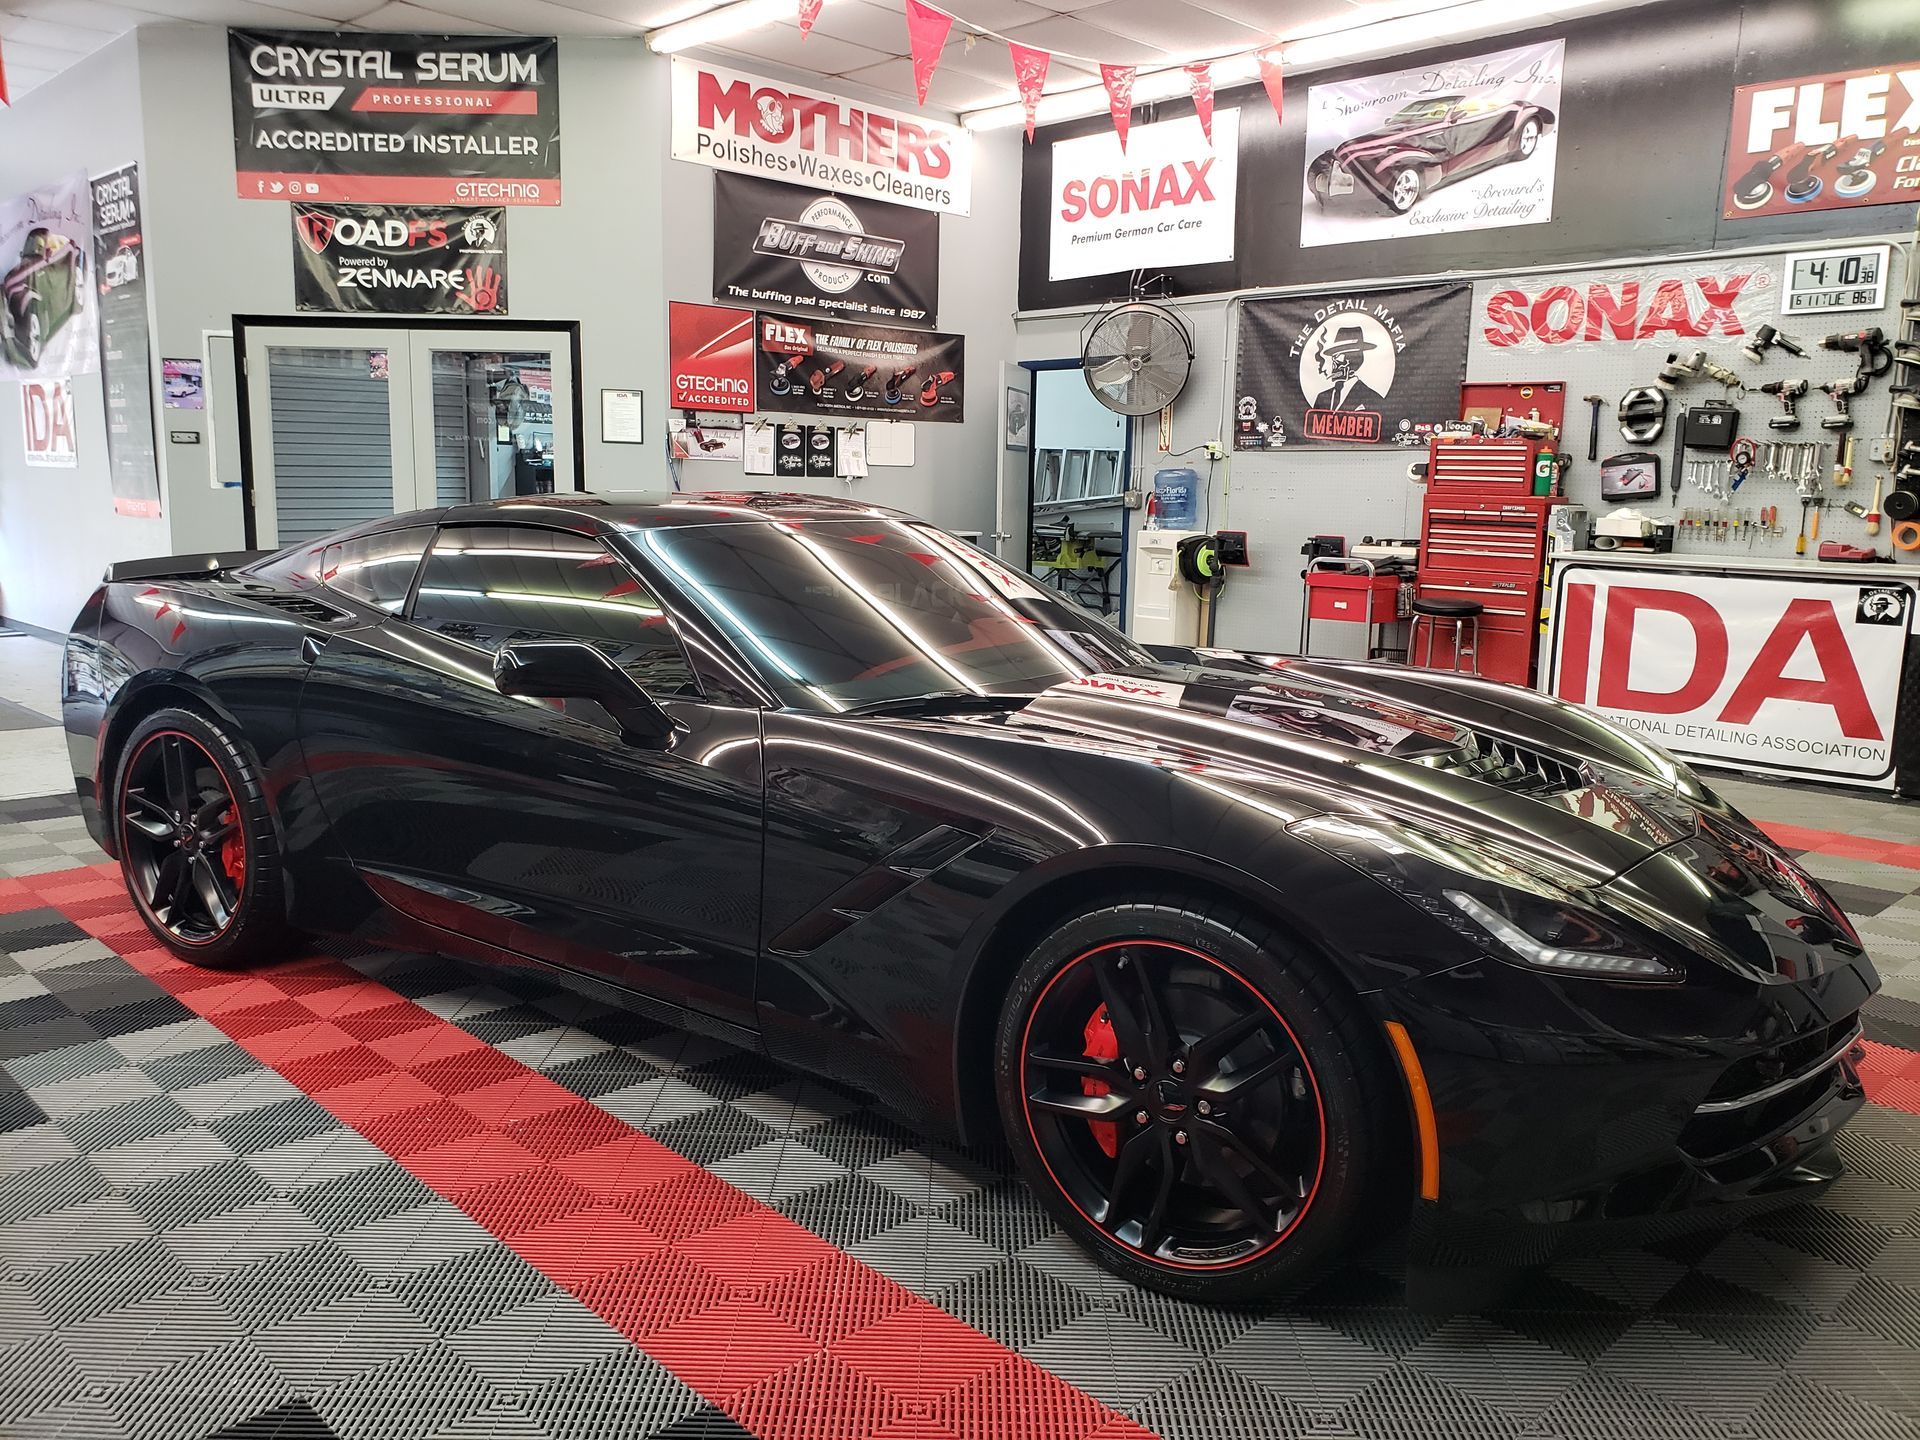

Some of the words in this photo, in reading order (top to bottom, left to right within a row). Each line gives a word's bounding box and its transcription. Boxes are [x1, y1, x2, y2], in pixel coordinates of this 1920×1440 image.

[250, 46, 403, 80] CRYSTAL
[416, 52, 537, 83] SERUM
[1419, 63, 1505, 95] Detailing
[260, 88, 325, 105] ULTRA
[372, 95, 493, 108] PROFESSIONAL
[698, 71, 951, 179] MOTHERS
[256, 130, 405, 153] ACCREDITED
[413, 135, 539, 156] INSTALLER
[95, 175, 133, 206] CRYSTAL
[456, 182, 540, 198] GTECHNIQ
[1061, 157, 1216, 223] SONAX
[811, 208, 854, 229] PERFORMANCE
[1409, 210, 1468, 226] Exclusive
[1071, 231, 1112, 245] Premium
[1114, 226, 1154, 239] German
[1157, 222, 1175, 233] Car
[1178, 219, 1203, 230] Care
[339, 257, 374, 268] Powered
[376, 258, 388, 270] by
[336, 267, 465, 290] ZENWARE
[813, 268, 850, 285] PRODUCTS
[864, 273, 891, 285] .com
[1860, 271, 1874, 284] 38
[727, 285, 749, 299] The
[752, 287, 792, 306] buffing
[795, 292, 816, 308] pad
[818, 296, 868, 313] specialist
[870, 302, 896, 316] since
[899, 302, 926, 320] 1987
[1483, 274, 1751, 347] SONAX
[765, 323, 807, 345] FLEX
[1289, 323, 1313, 358] THE
[1373, 303, 1407, 354] MAFIA
[816, 334, 830, 346] THE
[830, 336, 856, 348] FAMILY
[856, 338, 866, 350] OF
[866, 340, 882, 351] FLEX
[882, 342, 918, 354] POLISHERS
[676, 374, 748, 394] GTECHNIQ
[688, 394, 750, 406] ACCREDITED
[23, 382, 74, 452] IDA
[1312, 413, 1373, 438] MEMBER
[1535, 460, 1551, 477] G
[1558, 583, 1885, 741] IDA
[1675, 723, 1758, 746] DETAILING
[1762, 735, 1886, 762] ASSOCIATION
